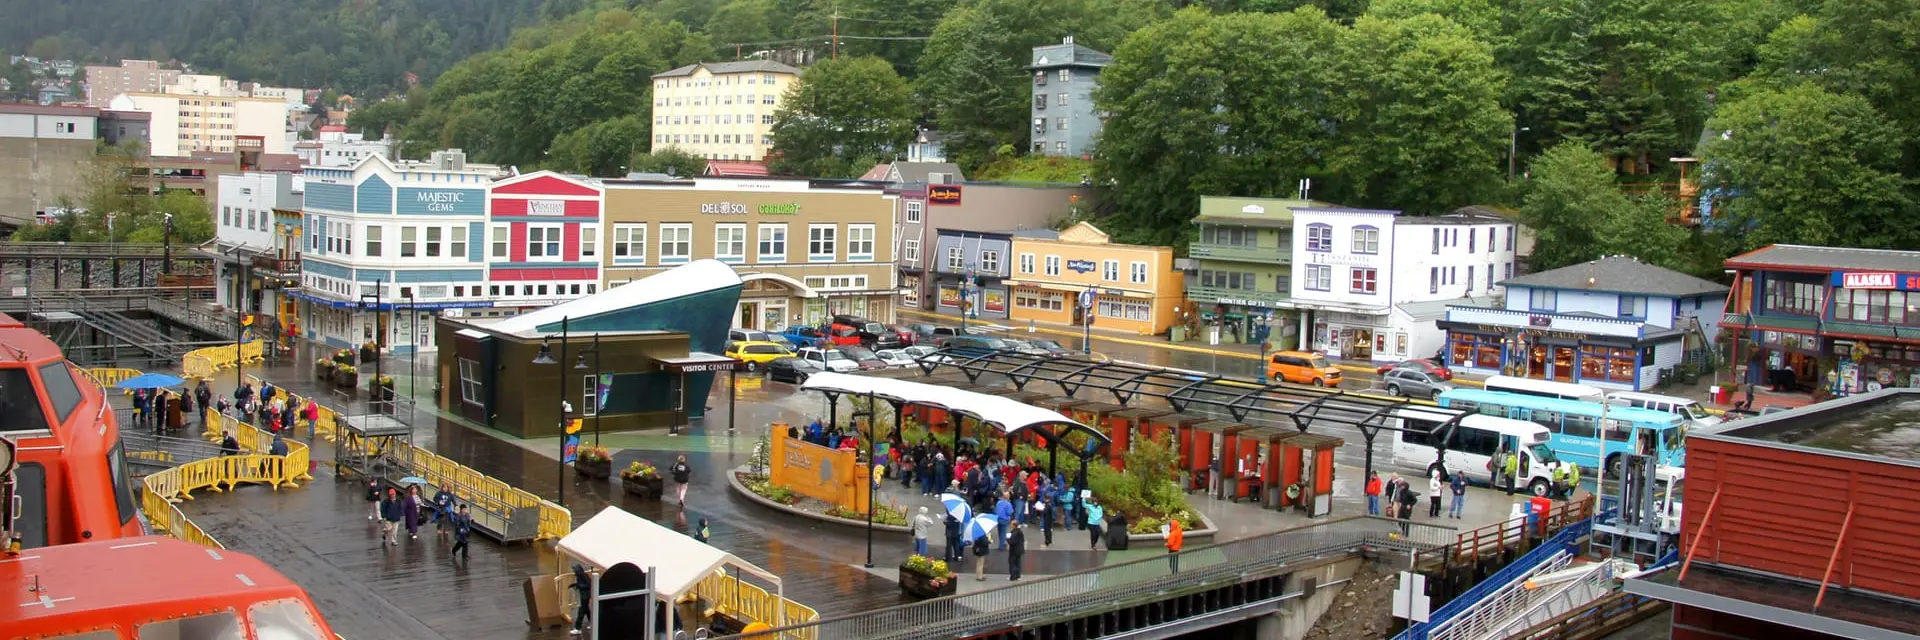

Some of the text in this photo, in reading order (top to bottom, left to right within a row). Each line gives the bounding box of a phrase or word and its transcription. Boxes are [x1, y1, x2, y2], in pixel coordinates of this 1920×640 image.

[417, 192, 464, 202] MAJESTIC
[428, 203, 454, 211] GEMS
[701, 203, 748, 214] DEL SOL
[1846, 274, 1892, 286] ALASKA
[1217, 297, 1266, 308] FRONTIER GIFTS
[1552, 331, 1588, 340] GALLERY
[682, 363, 735, 372] VISITOR CENTER
